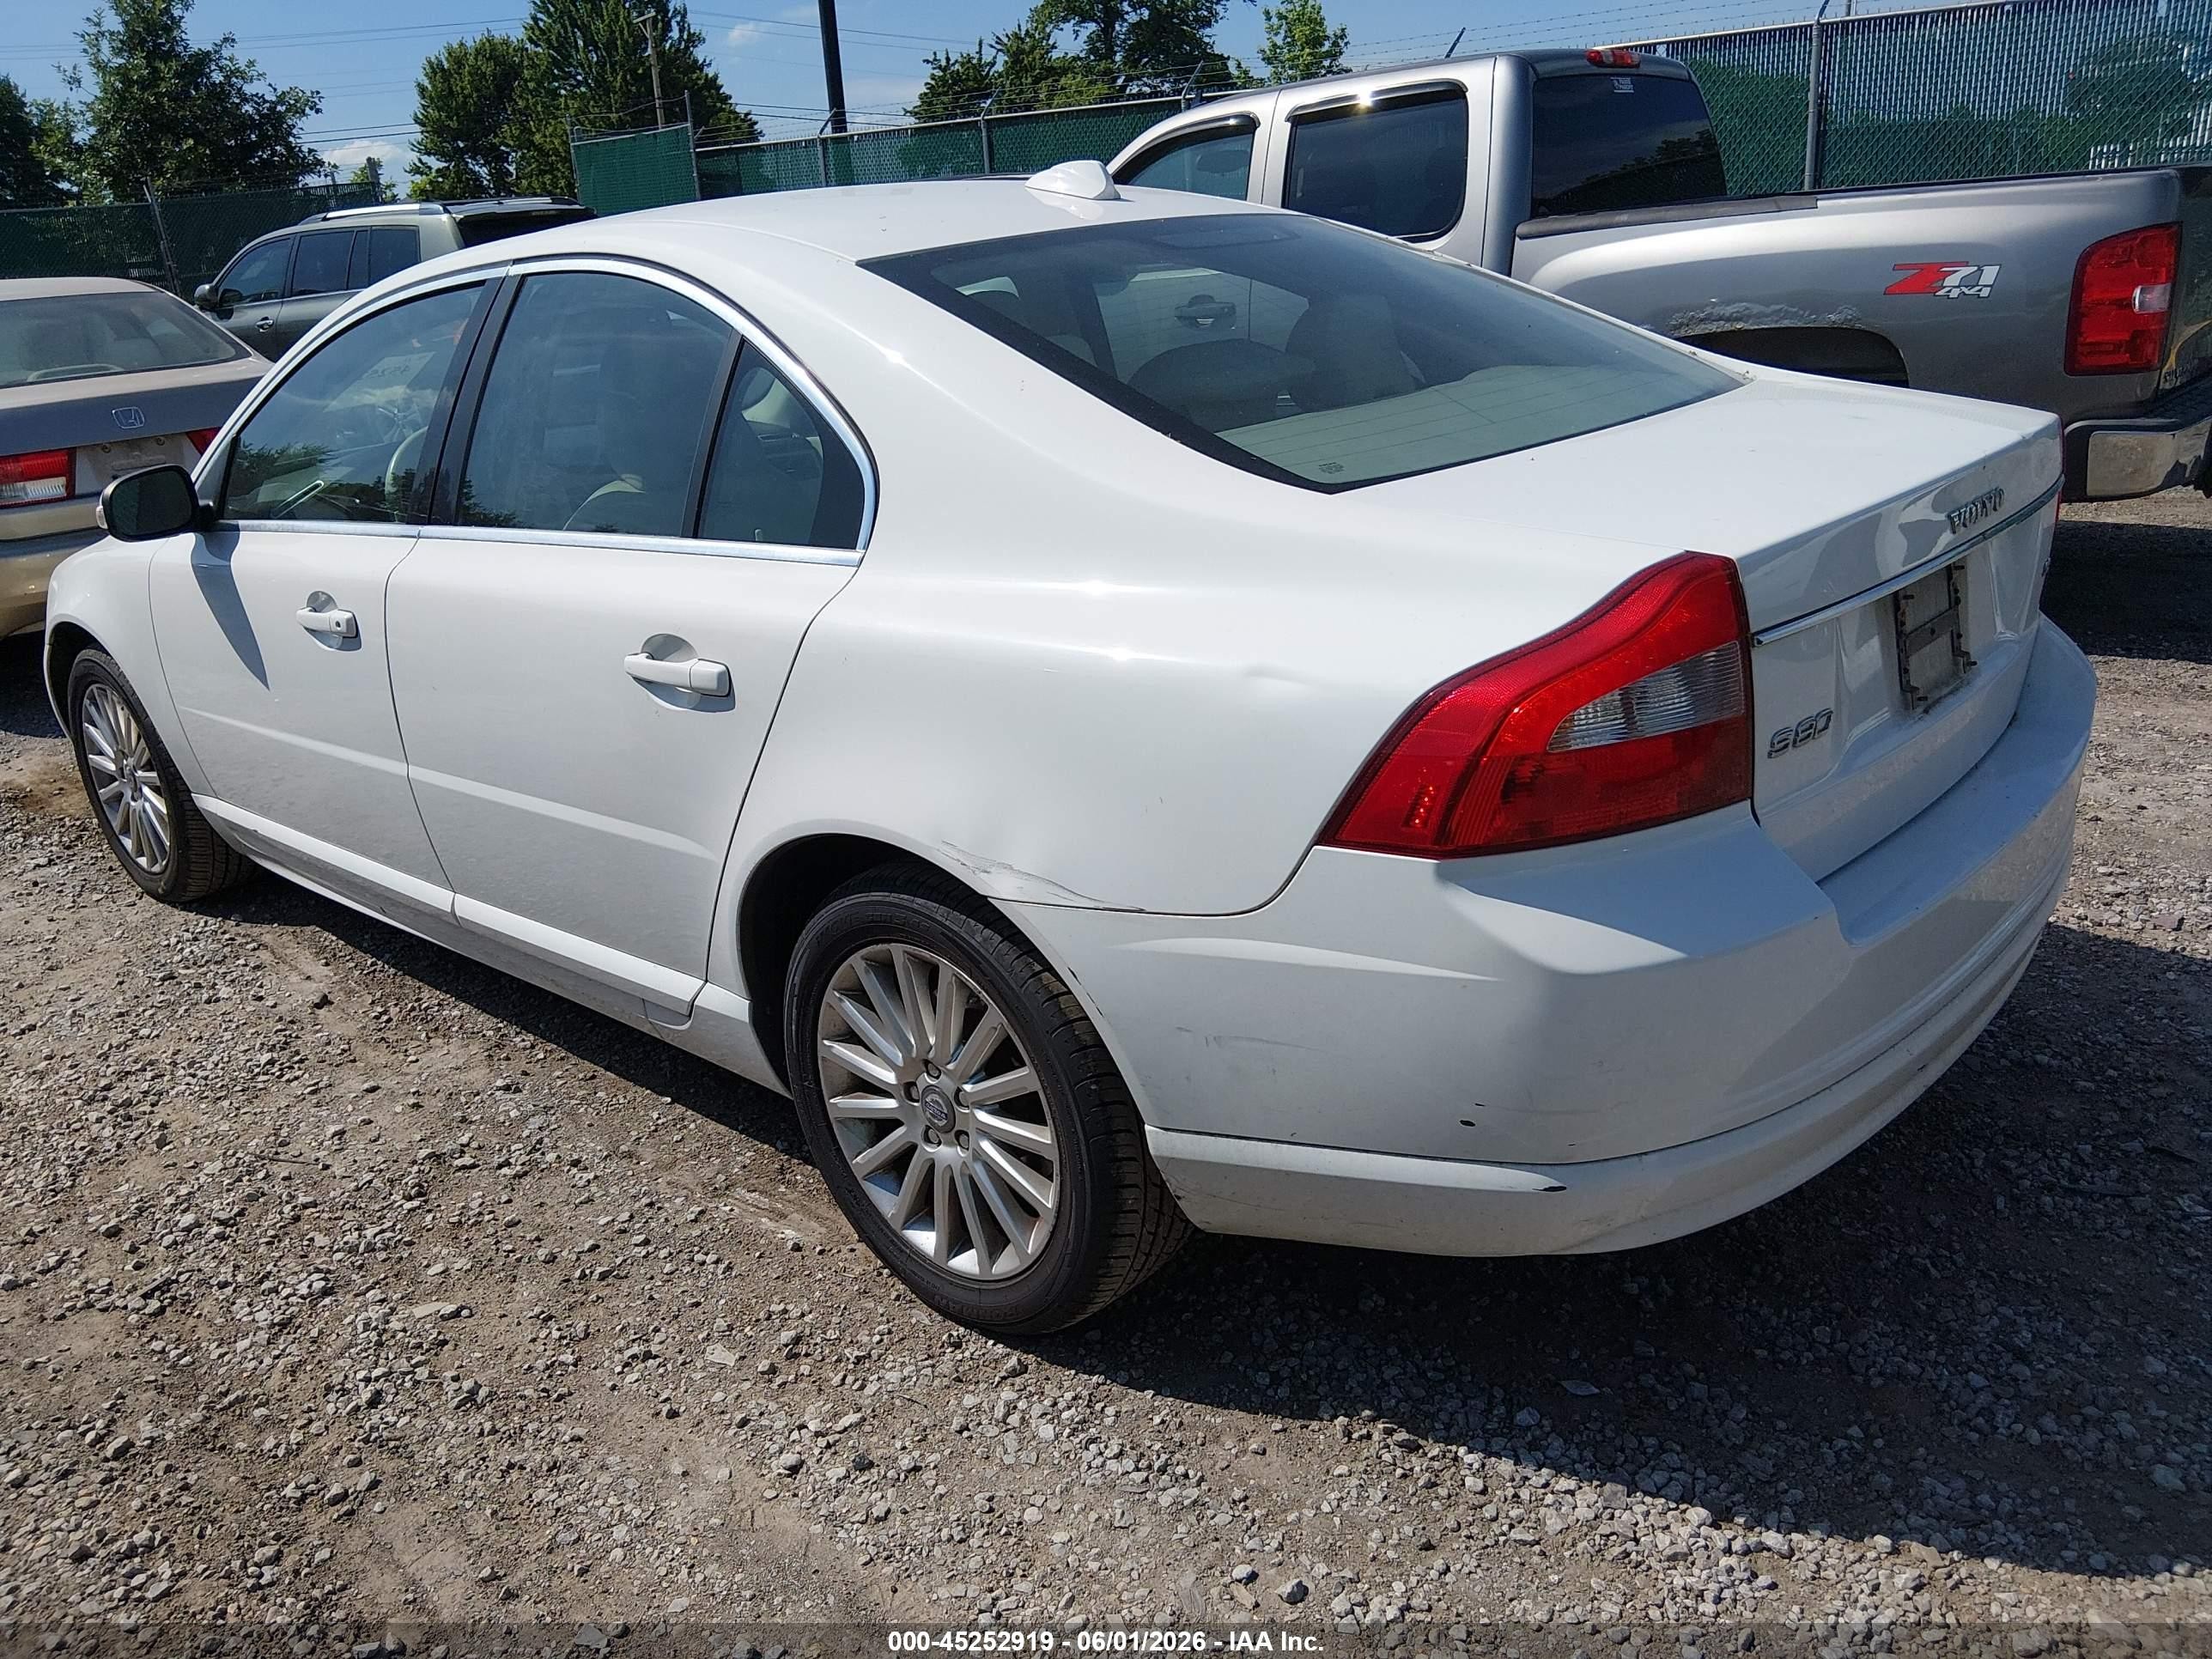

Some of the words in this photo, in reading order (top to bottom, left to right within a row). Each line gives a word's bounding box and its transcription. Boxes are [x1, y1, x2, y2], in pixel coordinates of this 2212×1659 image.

[1883, 261, 2002, 295] Z71
[1933, 285, 1993, 299] 4x4
[1948, 487, 2005, 534] VOLVO
[1767, 708, 1834, 759] S80
